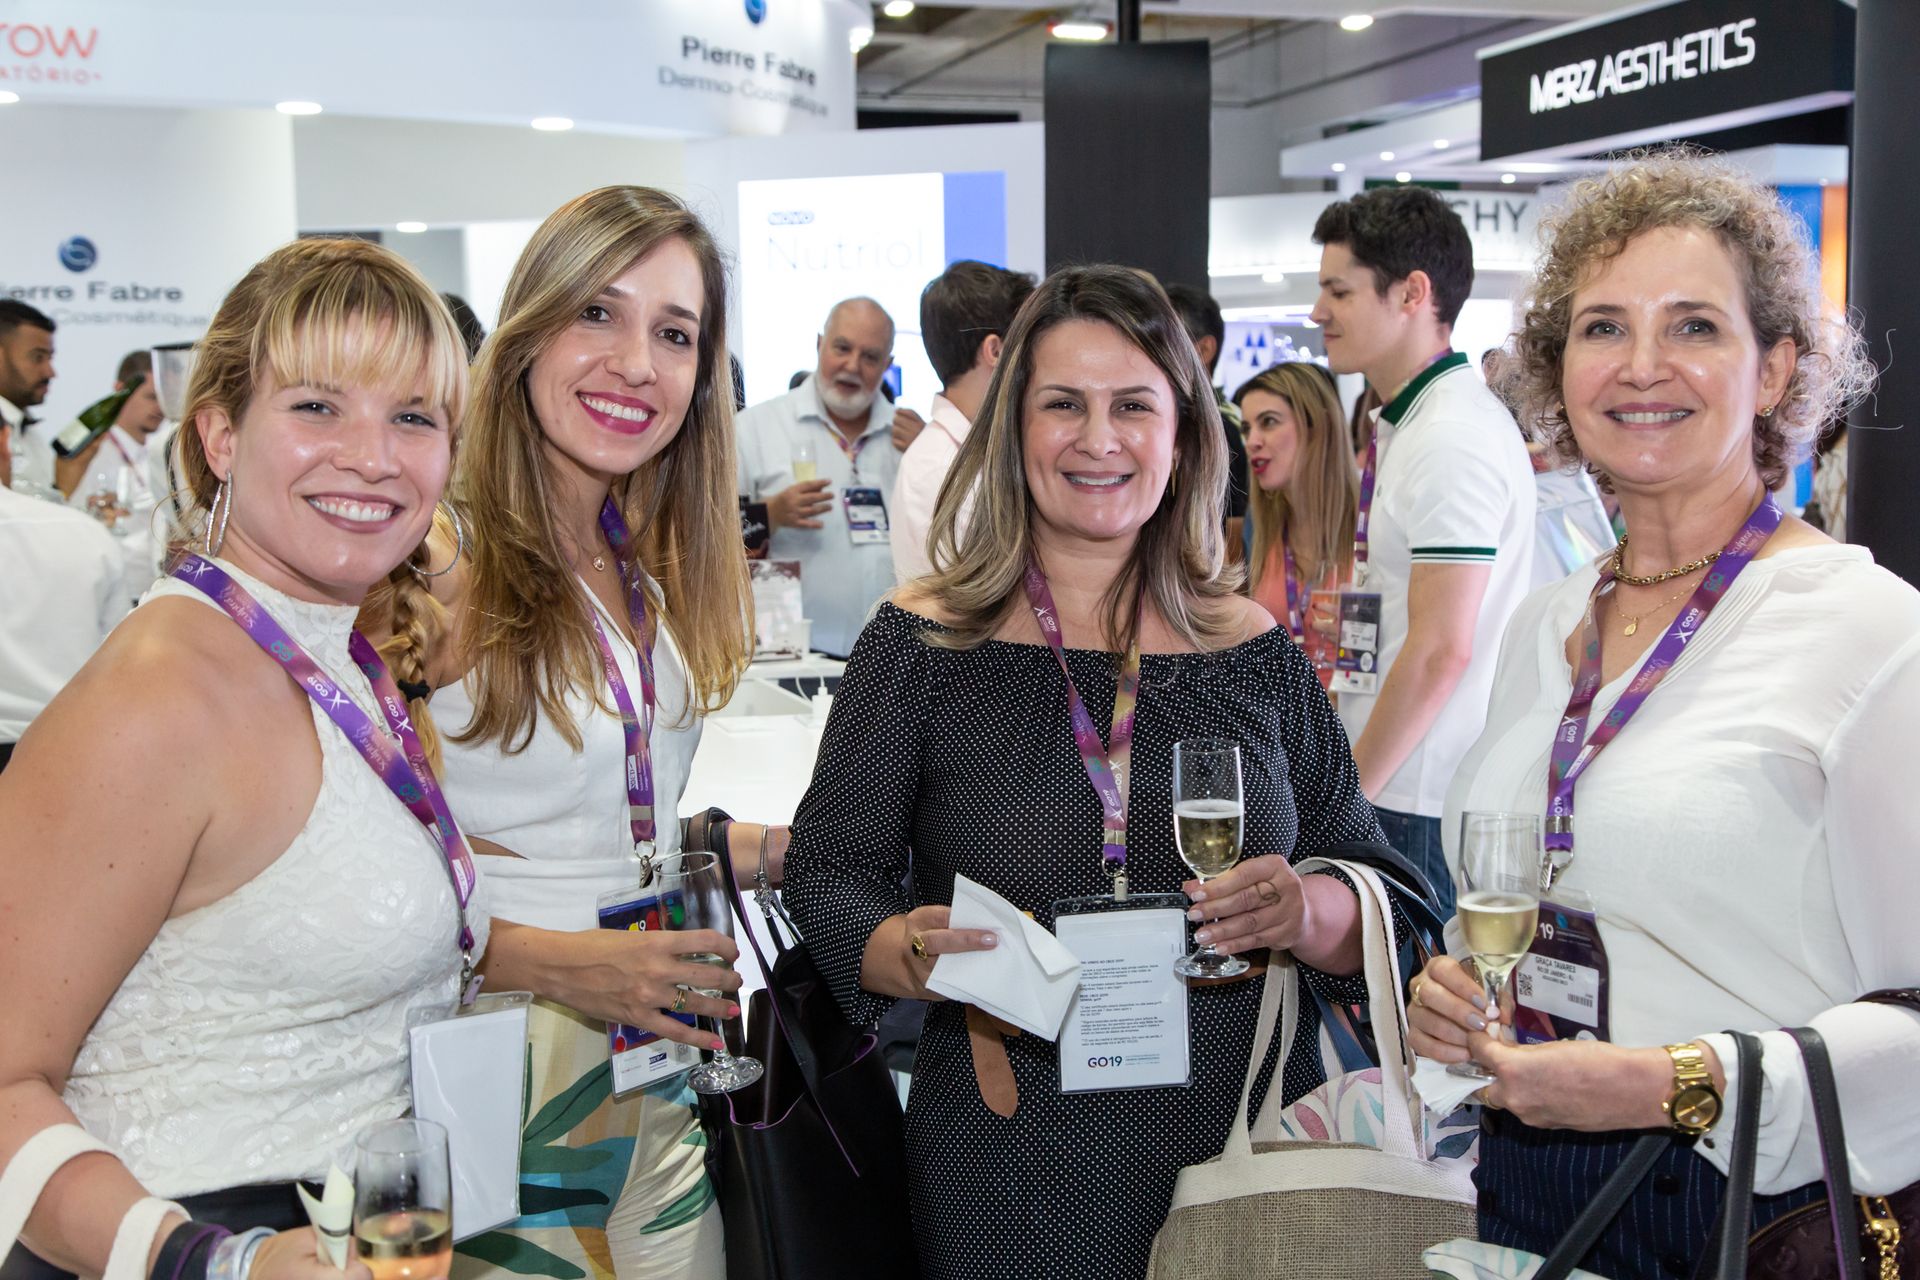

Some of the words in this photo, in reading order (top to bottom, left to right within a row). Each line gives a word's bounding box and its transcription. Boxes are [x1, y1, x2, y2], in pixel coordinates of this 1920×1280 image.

[682, 35, 755, 71] Pierre
[765, 52, 816, 86] Fabre
[1530, 59, 1596, 113] MERZ
[1597, 18, 1756, 98] AESTHETICS
[87, 281, 183, 301] Fabre
[1682, 607, 1700, 629] GO19
[306, 676, 329, 698] GO19
[384, 696, 399, 719] GO19
[1540, 922, 1555, 940] 19
[1088, 1056, 1122, 1068] GO19
